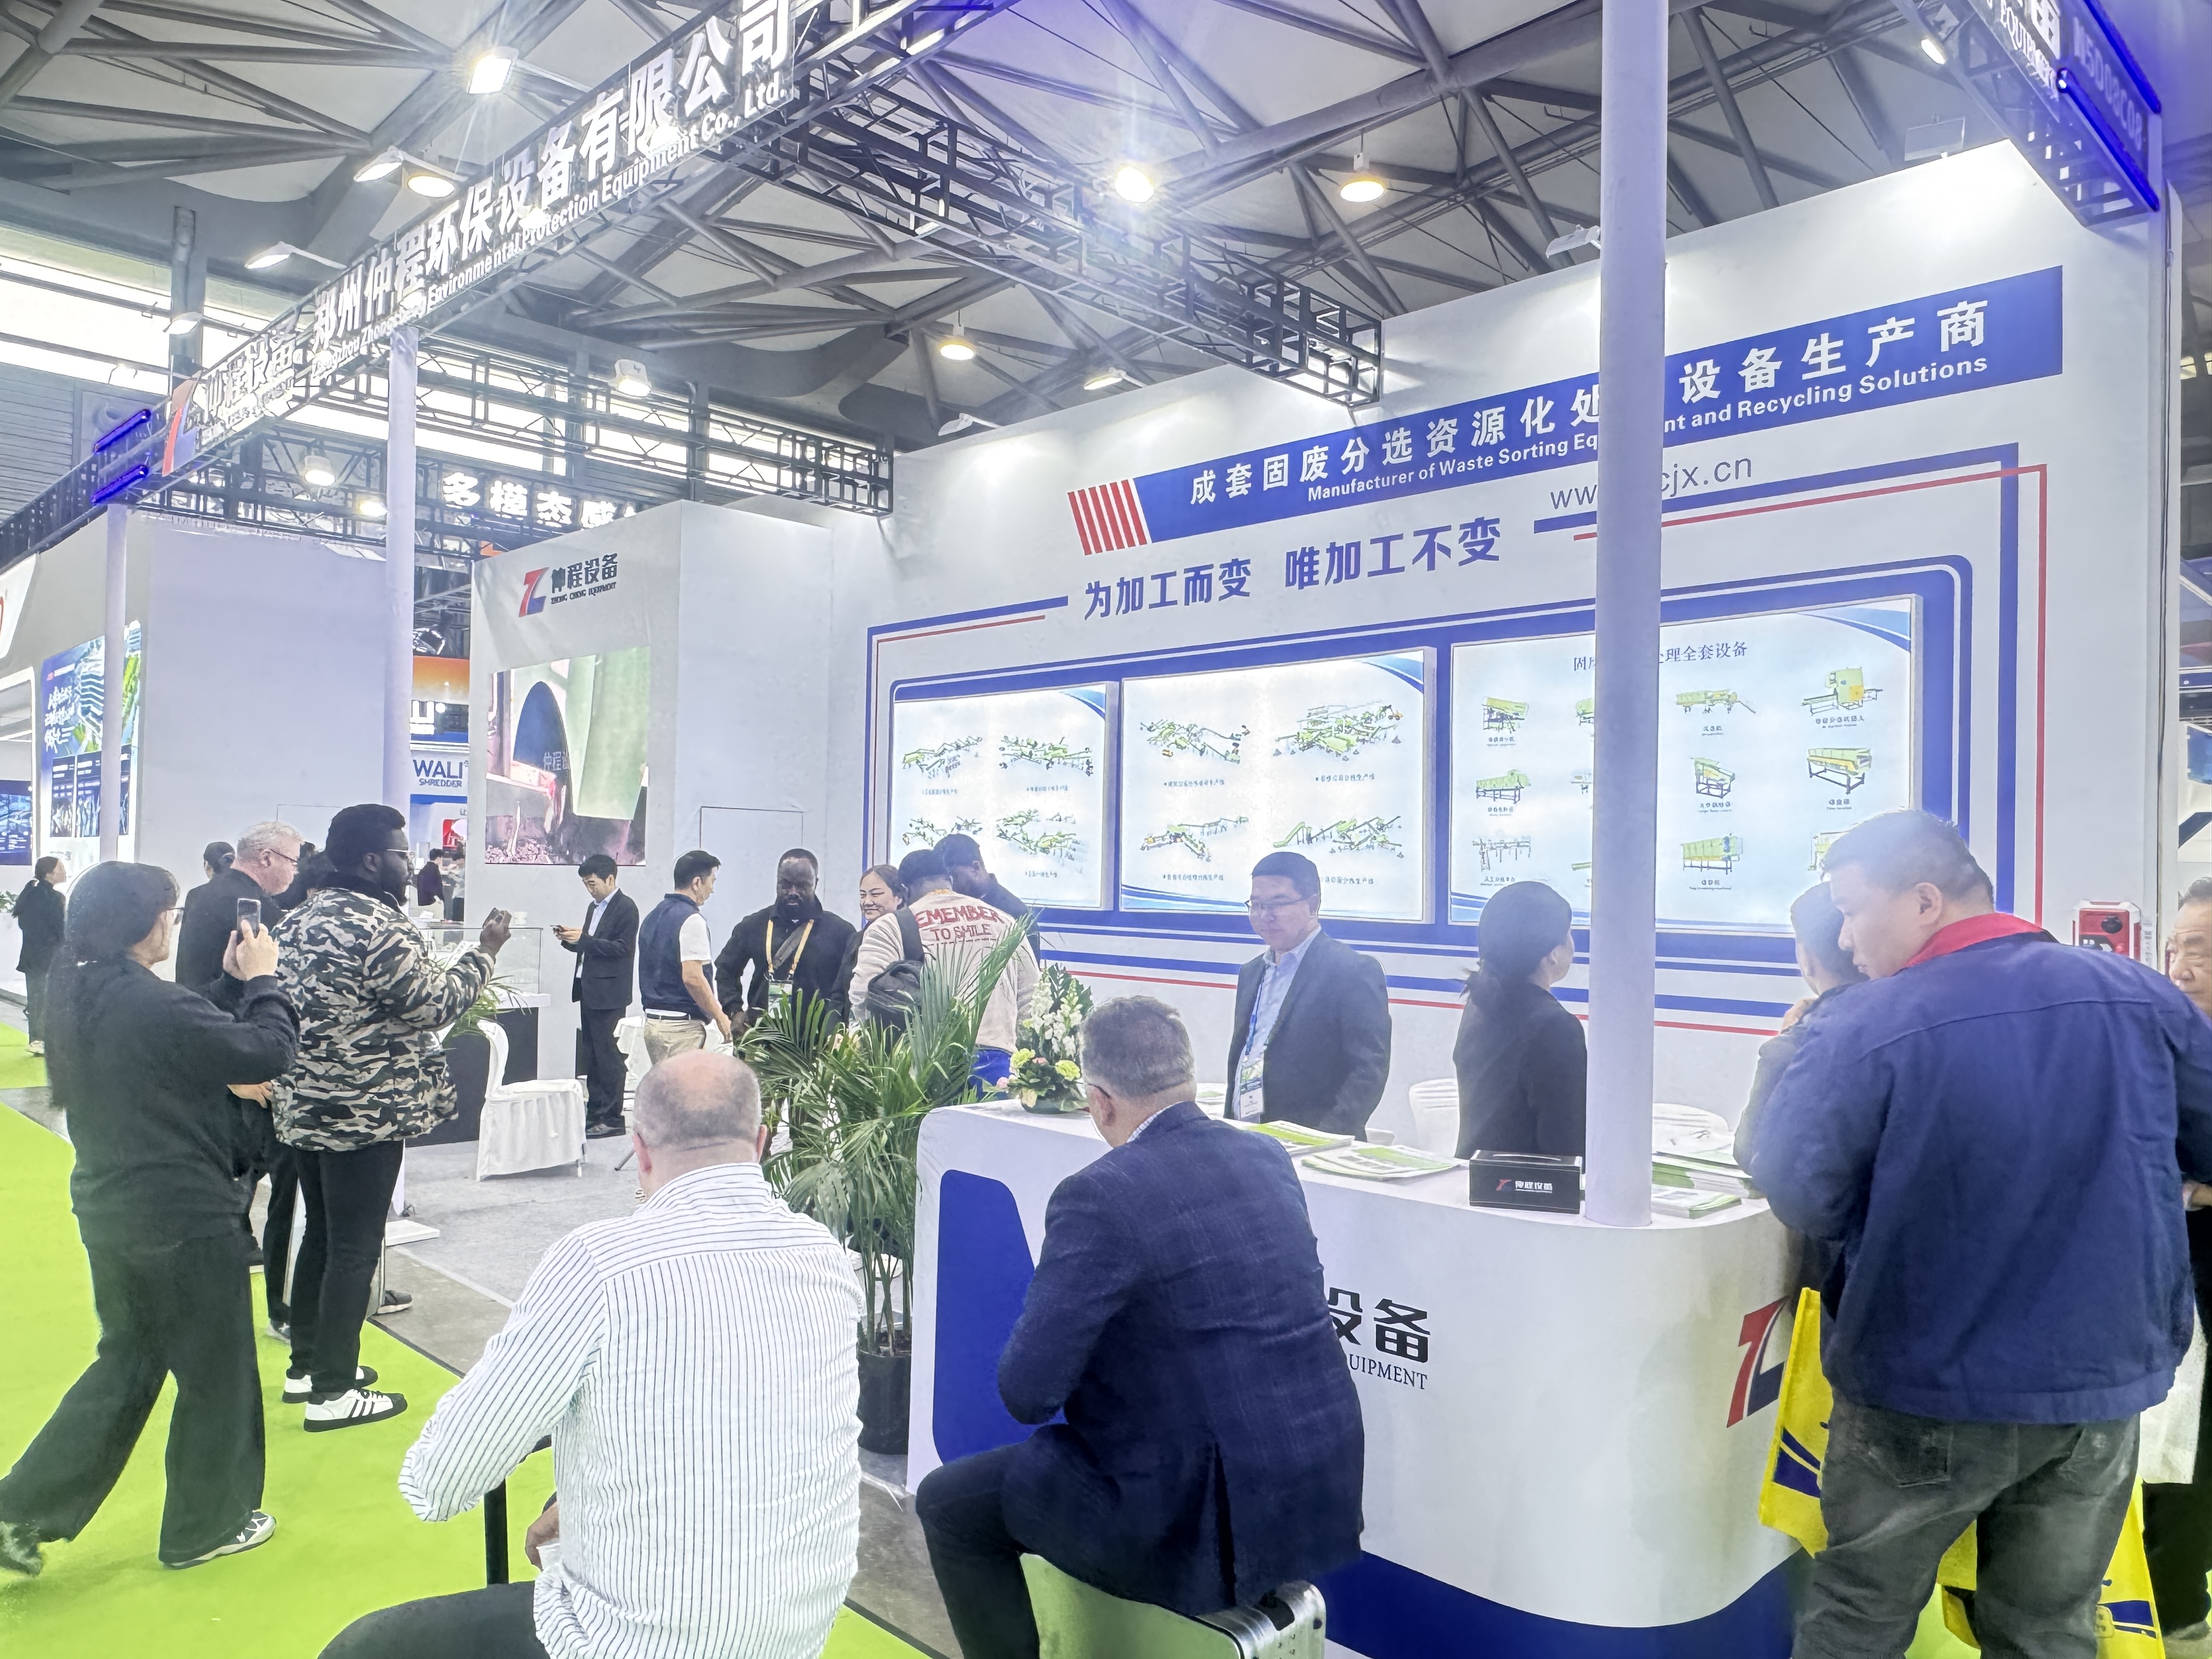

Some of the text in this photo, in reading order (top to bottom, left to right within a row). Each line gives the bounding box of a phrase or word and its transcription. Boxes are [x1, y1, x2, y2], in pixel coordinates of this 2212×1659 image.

[744, 71, 786, 119] Ltd.
[1191, 300, 1988, 505] 成套固废分选资源化处设备生产商
[1308, 357, 1988, 501] Manufacturer of Waste Sorting and Recycling Solutions
[1085, 516, 1501, 620] 为加工而变 唯加工不变
[413, 759, 462, 779] WALI
[915, 905, 1005, 928] EMEMBER
[930, 924, 992, 941] TO SMILE
[1349, 1353, 1428, 1390] UIPMENT
